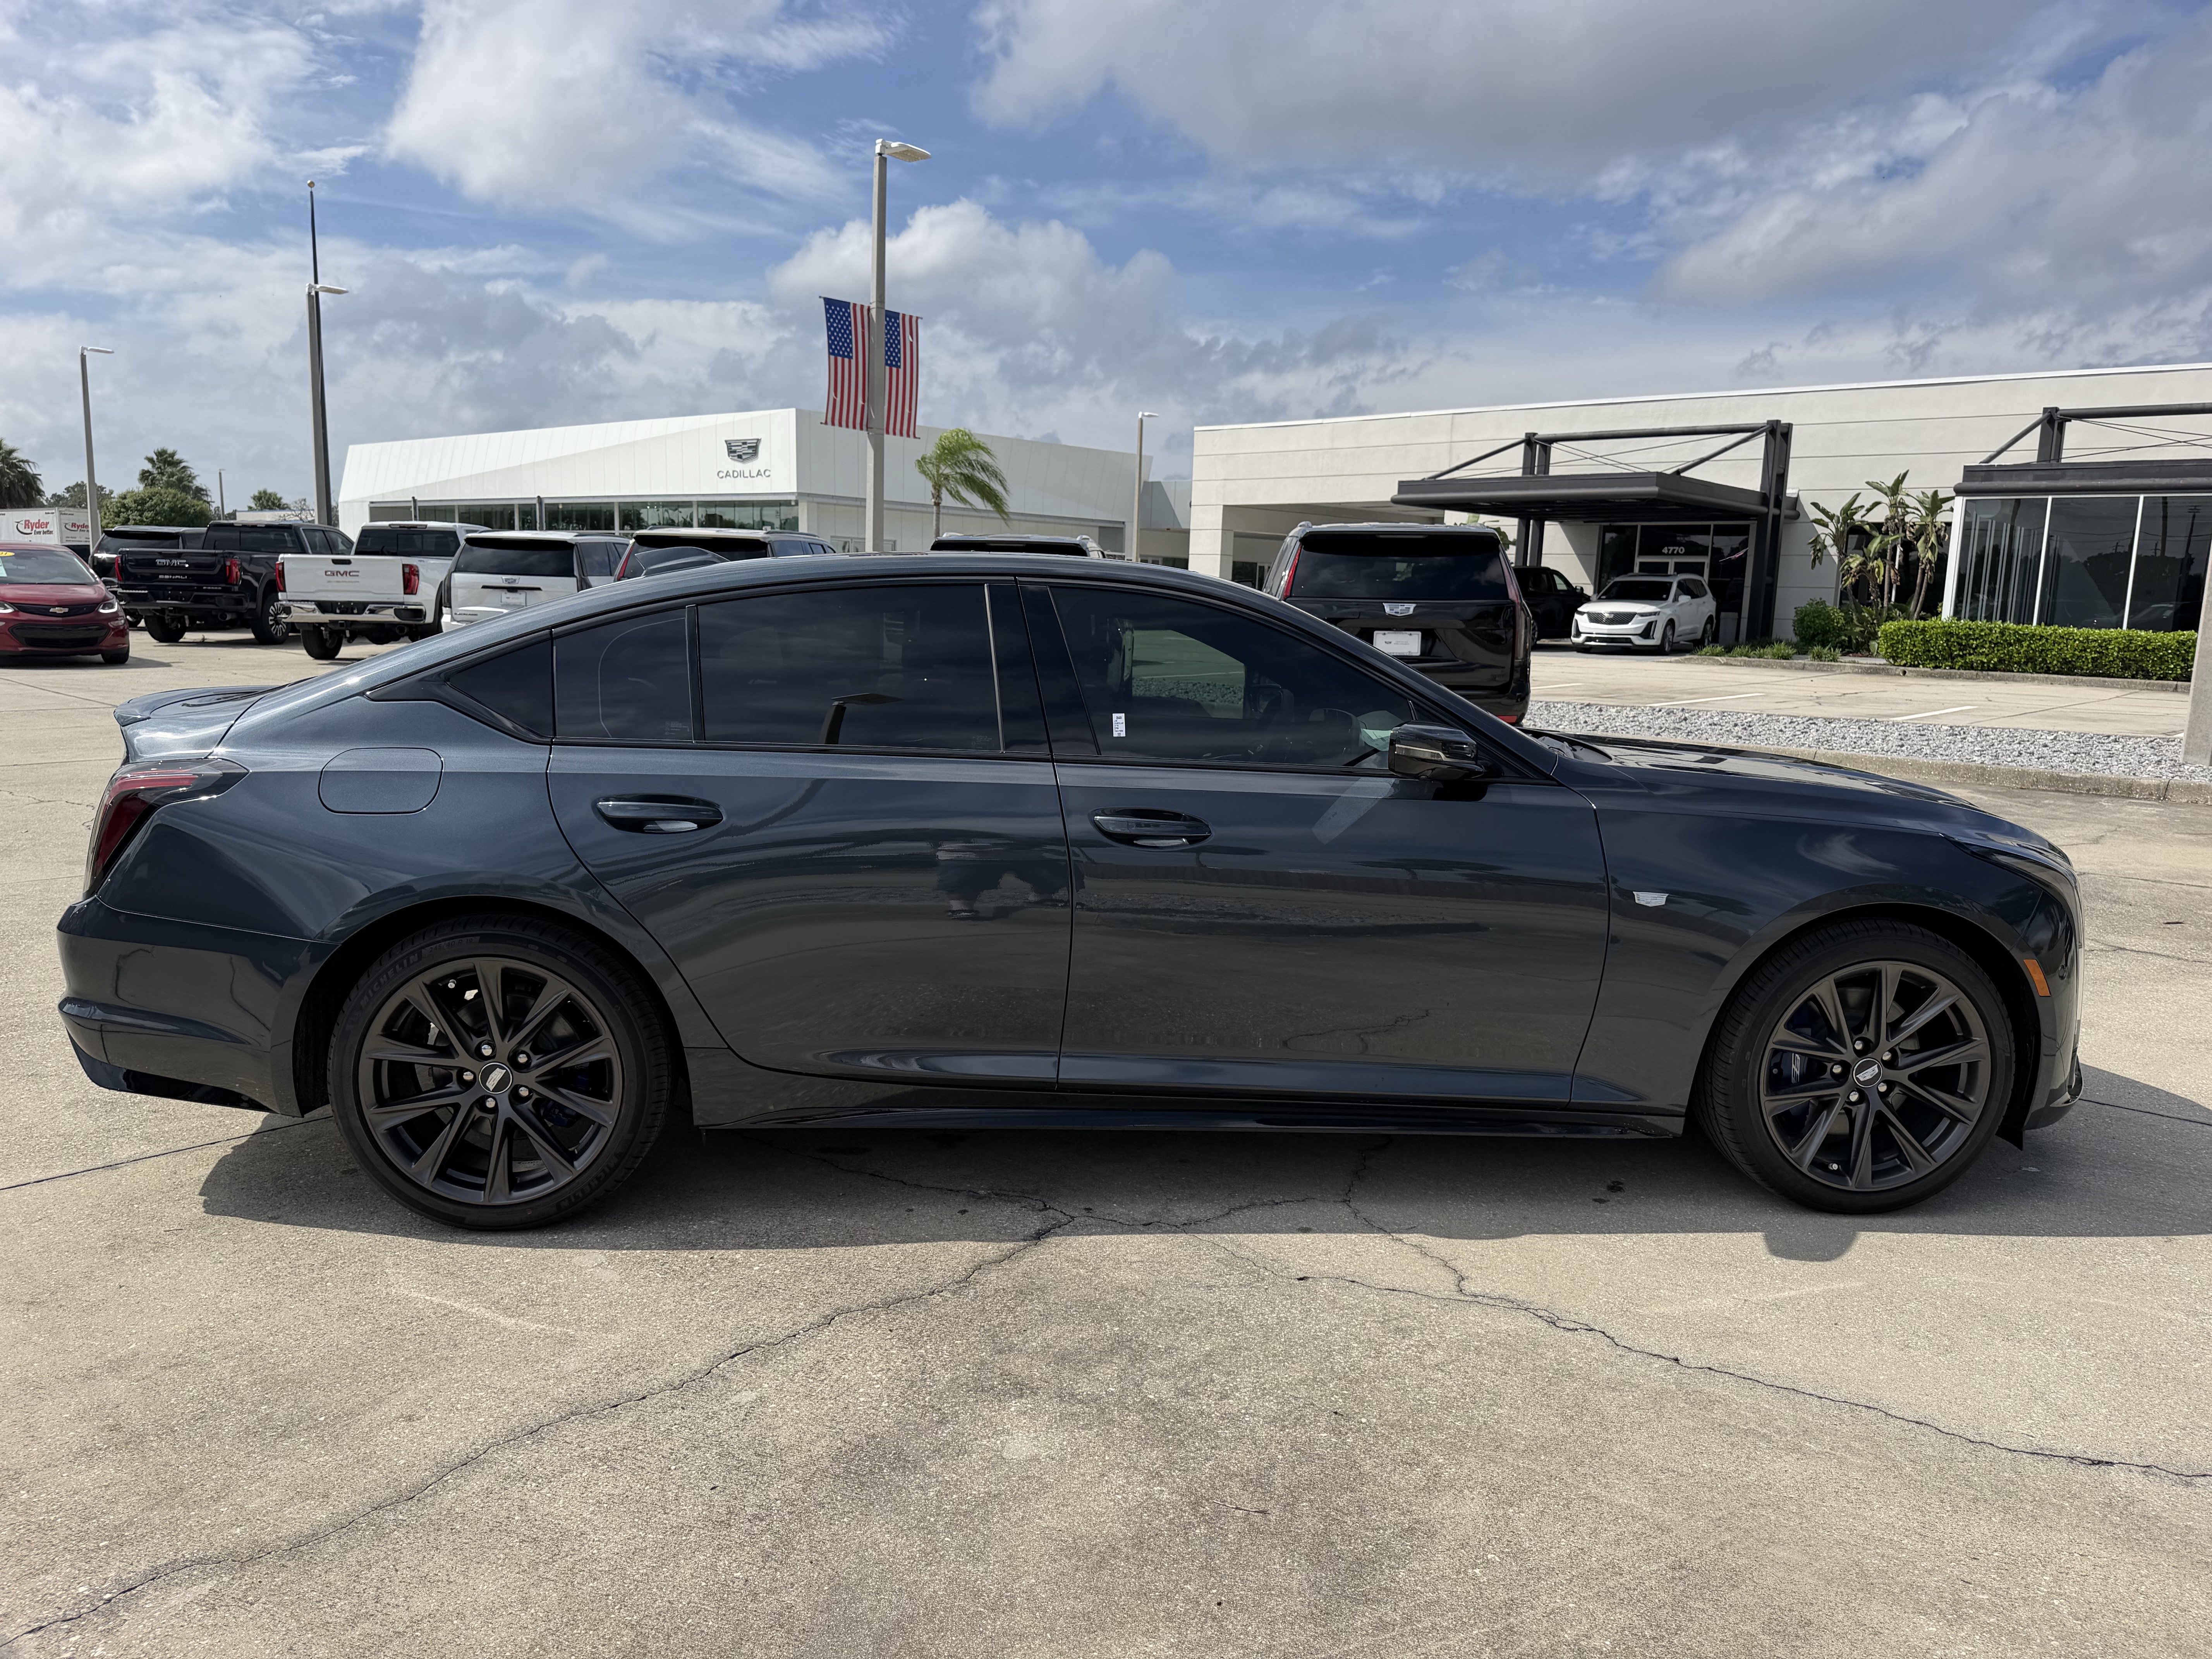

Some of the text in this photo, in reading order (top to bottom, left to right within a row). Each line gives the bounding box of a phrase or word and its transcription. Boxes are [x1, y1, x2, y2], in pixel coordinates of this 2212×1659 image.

[717, 469, 771, 479] CADILLAC
[24, 519, 50, 531] Ryder
[359, 953, 418, 1009] MICHELIN
[560, 1156, 618, 1208] MICHELIN
